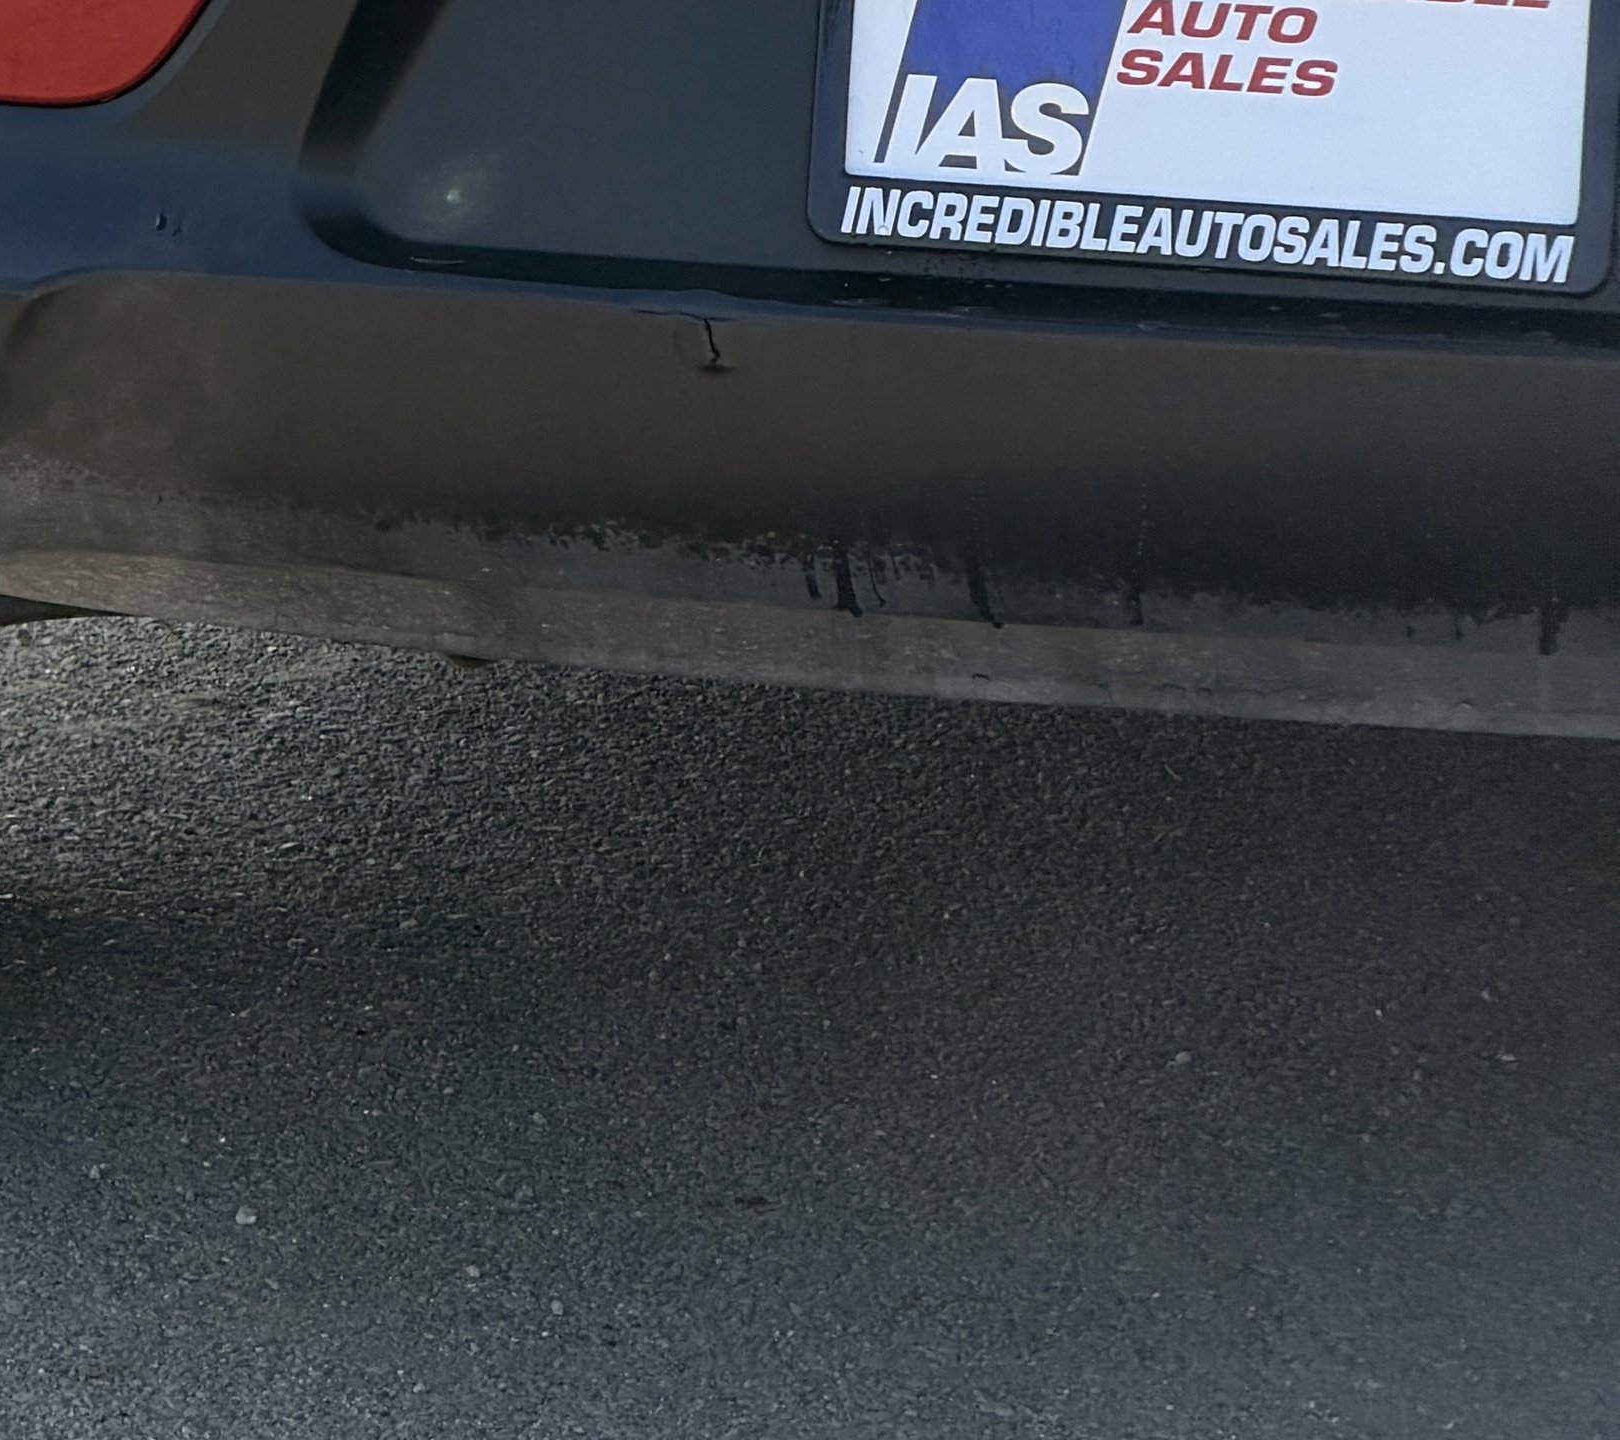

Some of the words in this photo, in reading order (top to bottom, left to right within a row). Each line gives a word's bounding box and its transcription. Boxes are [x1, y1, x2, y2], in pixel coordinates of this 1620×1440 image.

[1127, 0, 1318, 44] AUTO
[1116, 49, 1339, 97] SALES
[883, 73, 1090, 175] IAS
[840, 186, 1575, 284] INCREDIBLEAUTOSALES.COM
